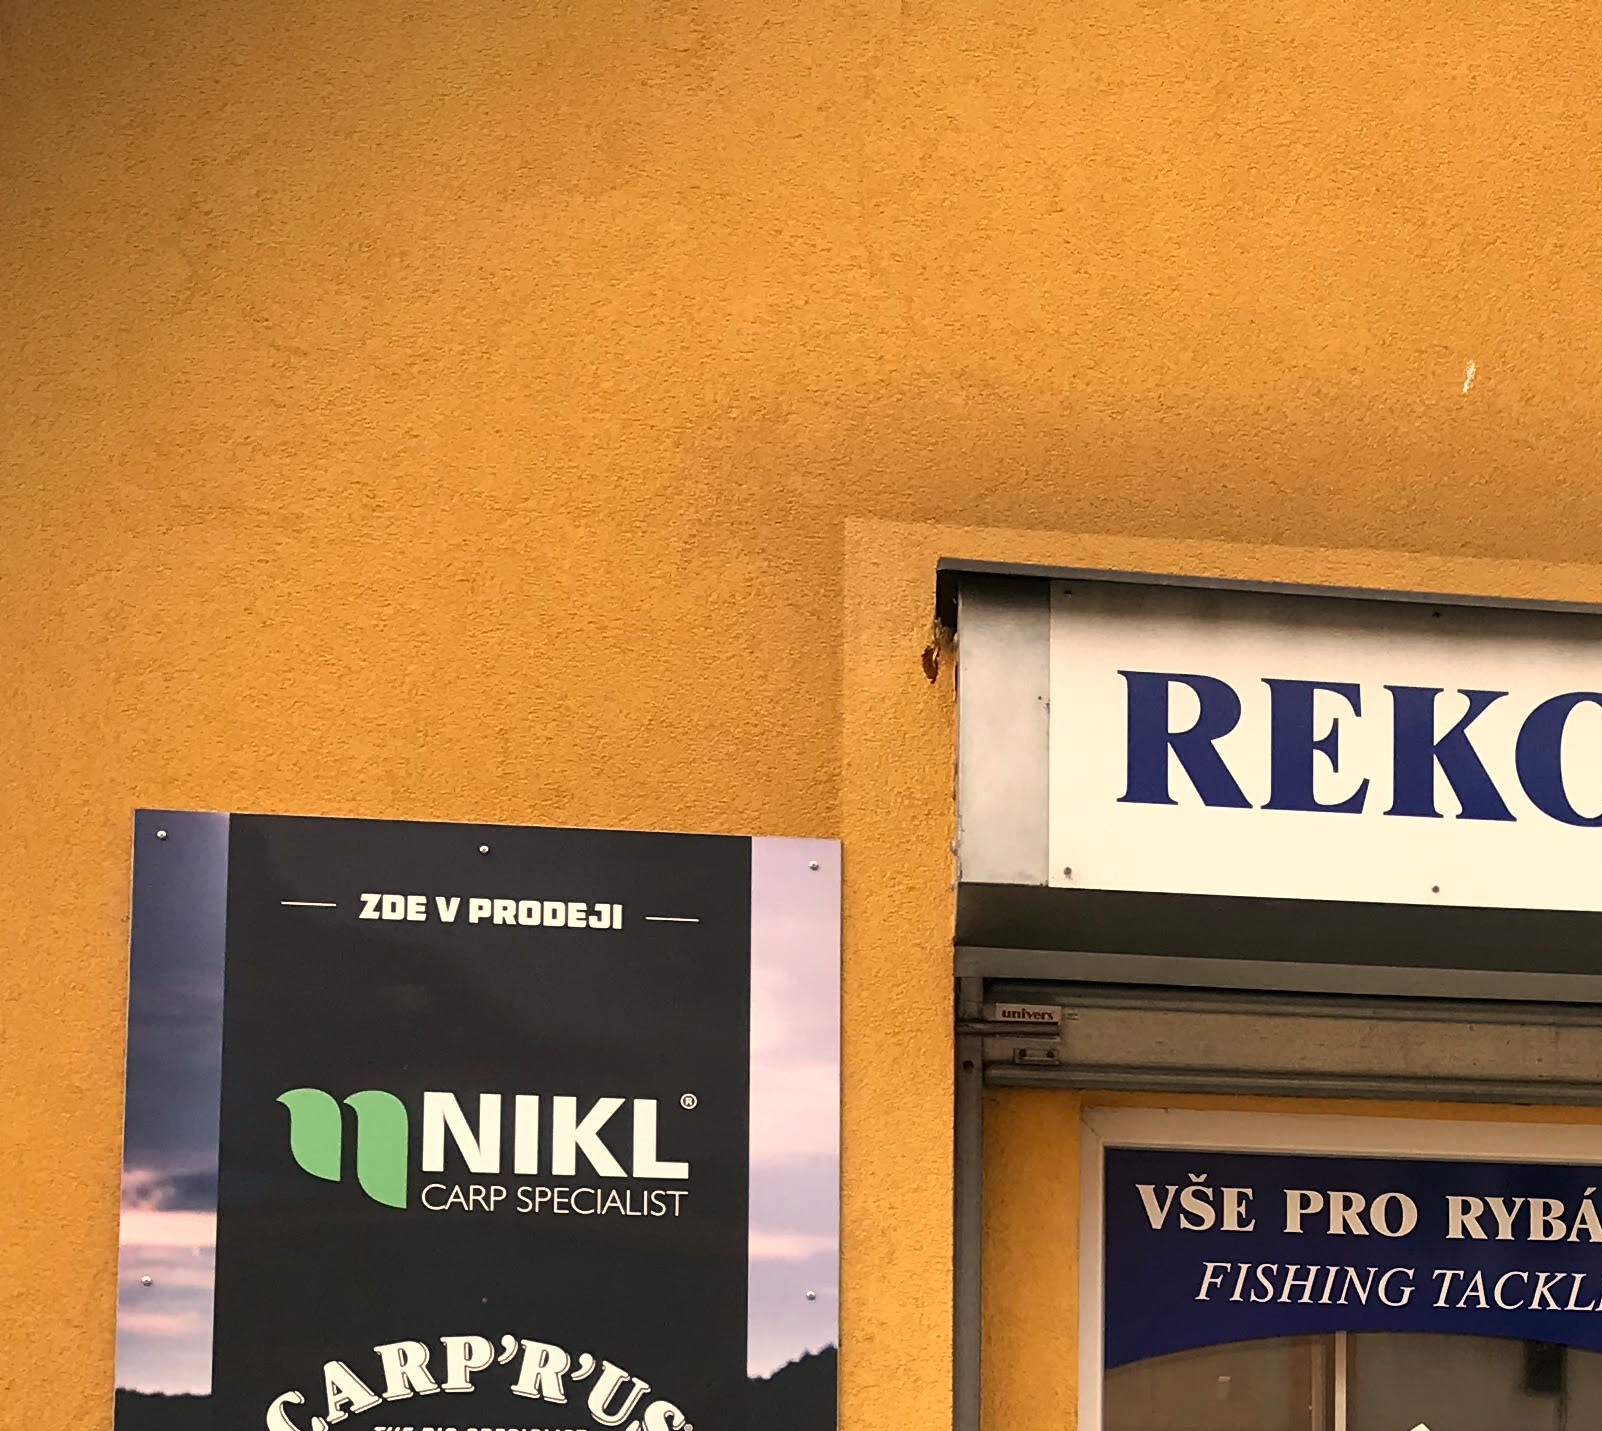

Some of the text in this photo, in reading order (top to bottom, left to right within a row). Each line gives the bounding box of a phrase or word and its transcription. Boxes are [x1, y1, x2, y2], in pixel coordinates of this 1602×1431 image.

[359, 893, 623, 930] ZDE V PRODEJI
[1002, 1008, 1053, 1020] univers
[421, 1091, 690, 1179] NIKL
[421, 1184, 689, 1218] CARP SPECIALIST
[1135, 1174, 1257, 1233] VŠE
[1283, 1188, 1418, 1237] PRO
[1195, 1261, 1416, 1308] FISHING
